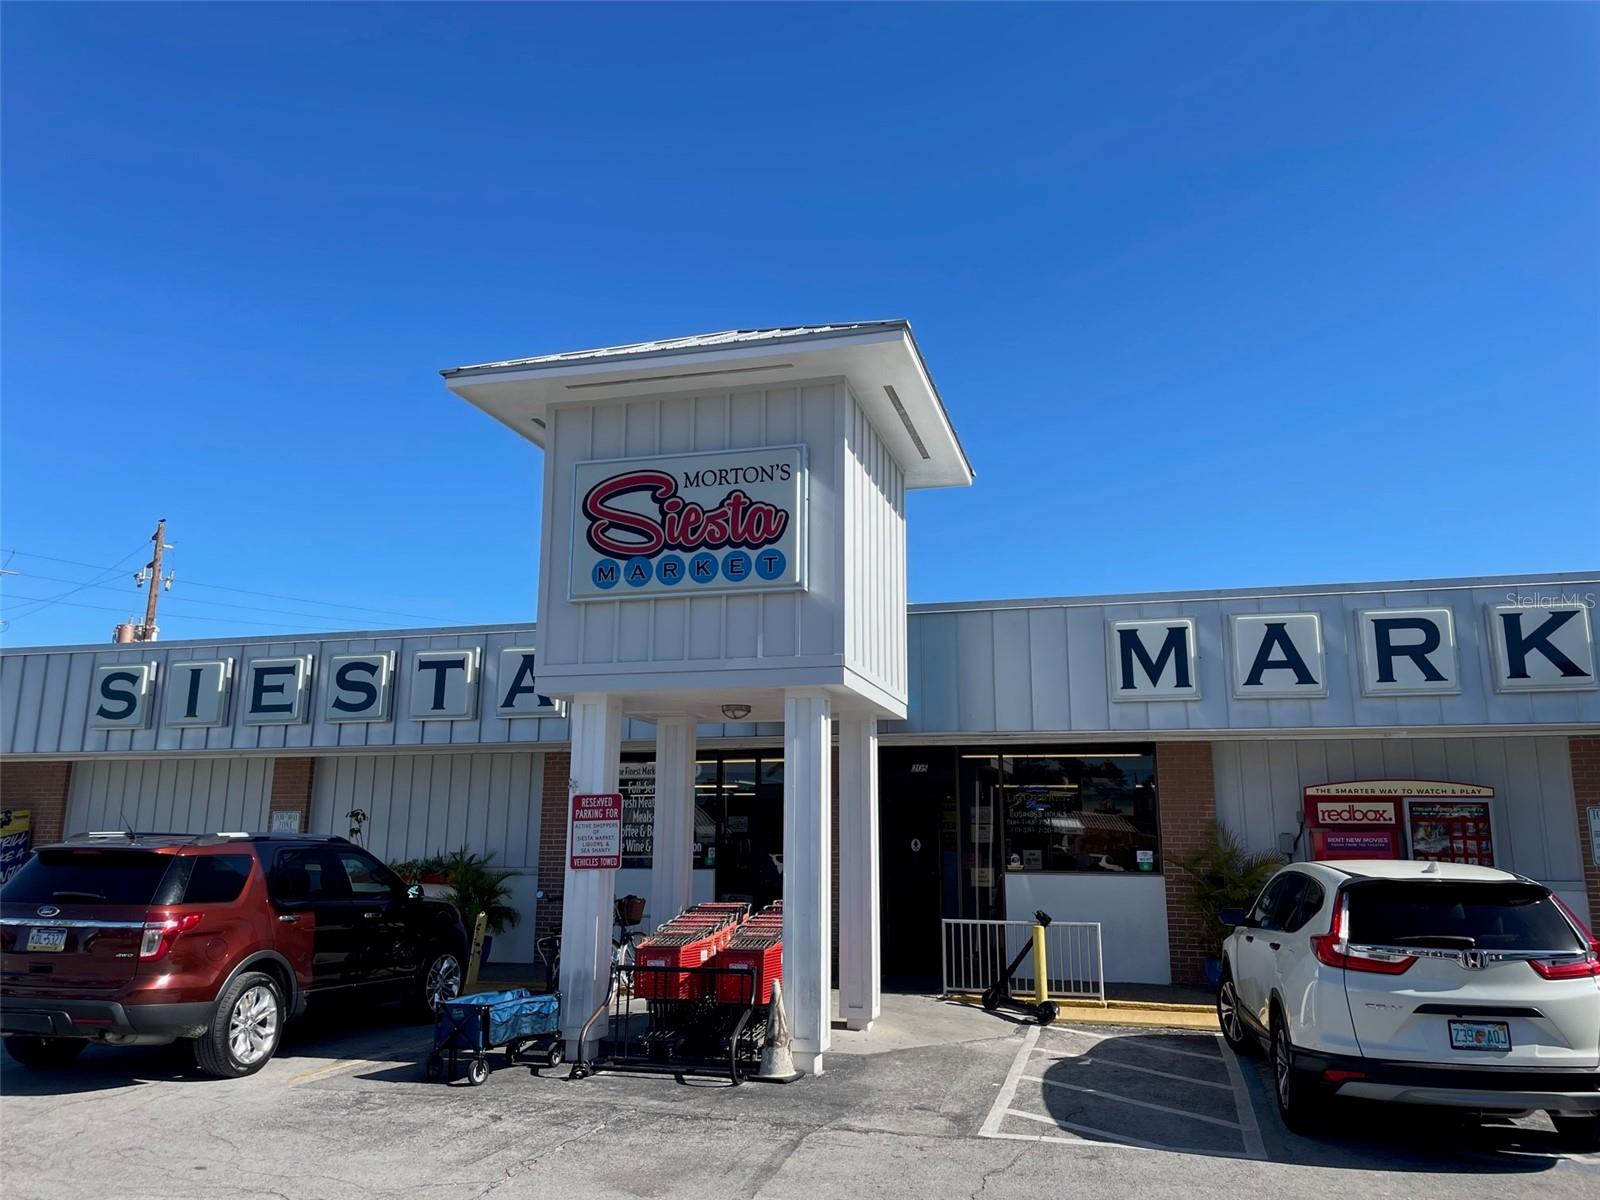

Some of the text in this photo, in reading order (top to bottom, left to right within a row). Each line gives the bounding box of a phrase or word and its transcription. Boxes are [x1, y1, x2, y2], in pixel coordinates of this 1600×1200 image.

[683, 463, 791, 488] MORTON'S
[582, 470, 789, 560] Siesta
[595, 555, 781, 584] MARKET
[1116, 610, 1591, 689] MARK
[95, 654, 556, 721] SIESTA
[642, 766, 656, 776] Mark
[628, 780, 655, 794] Full-Ser
[581, 797, 613, 807] RESERVED
[623, 796, 637, 808] resh
[575, 808, 619, 819] PARKING FOR
[622, 824, 639, 837] offee
[625, 838, 645, 852] Wine
[574, 858, 618, 866] VEHICLES TOWED
